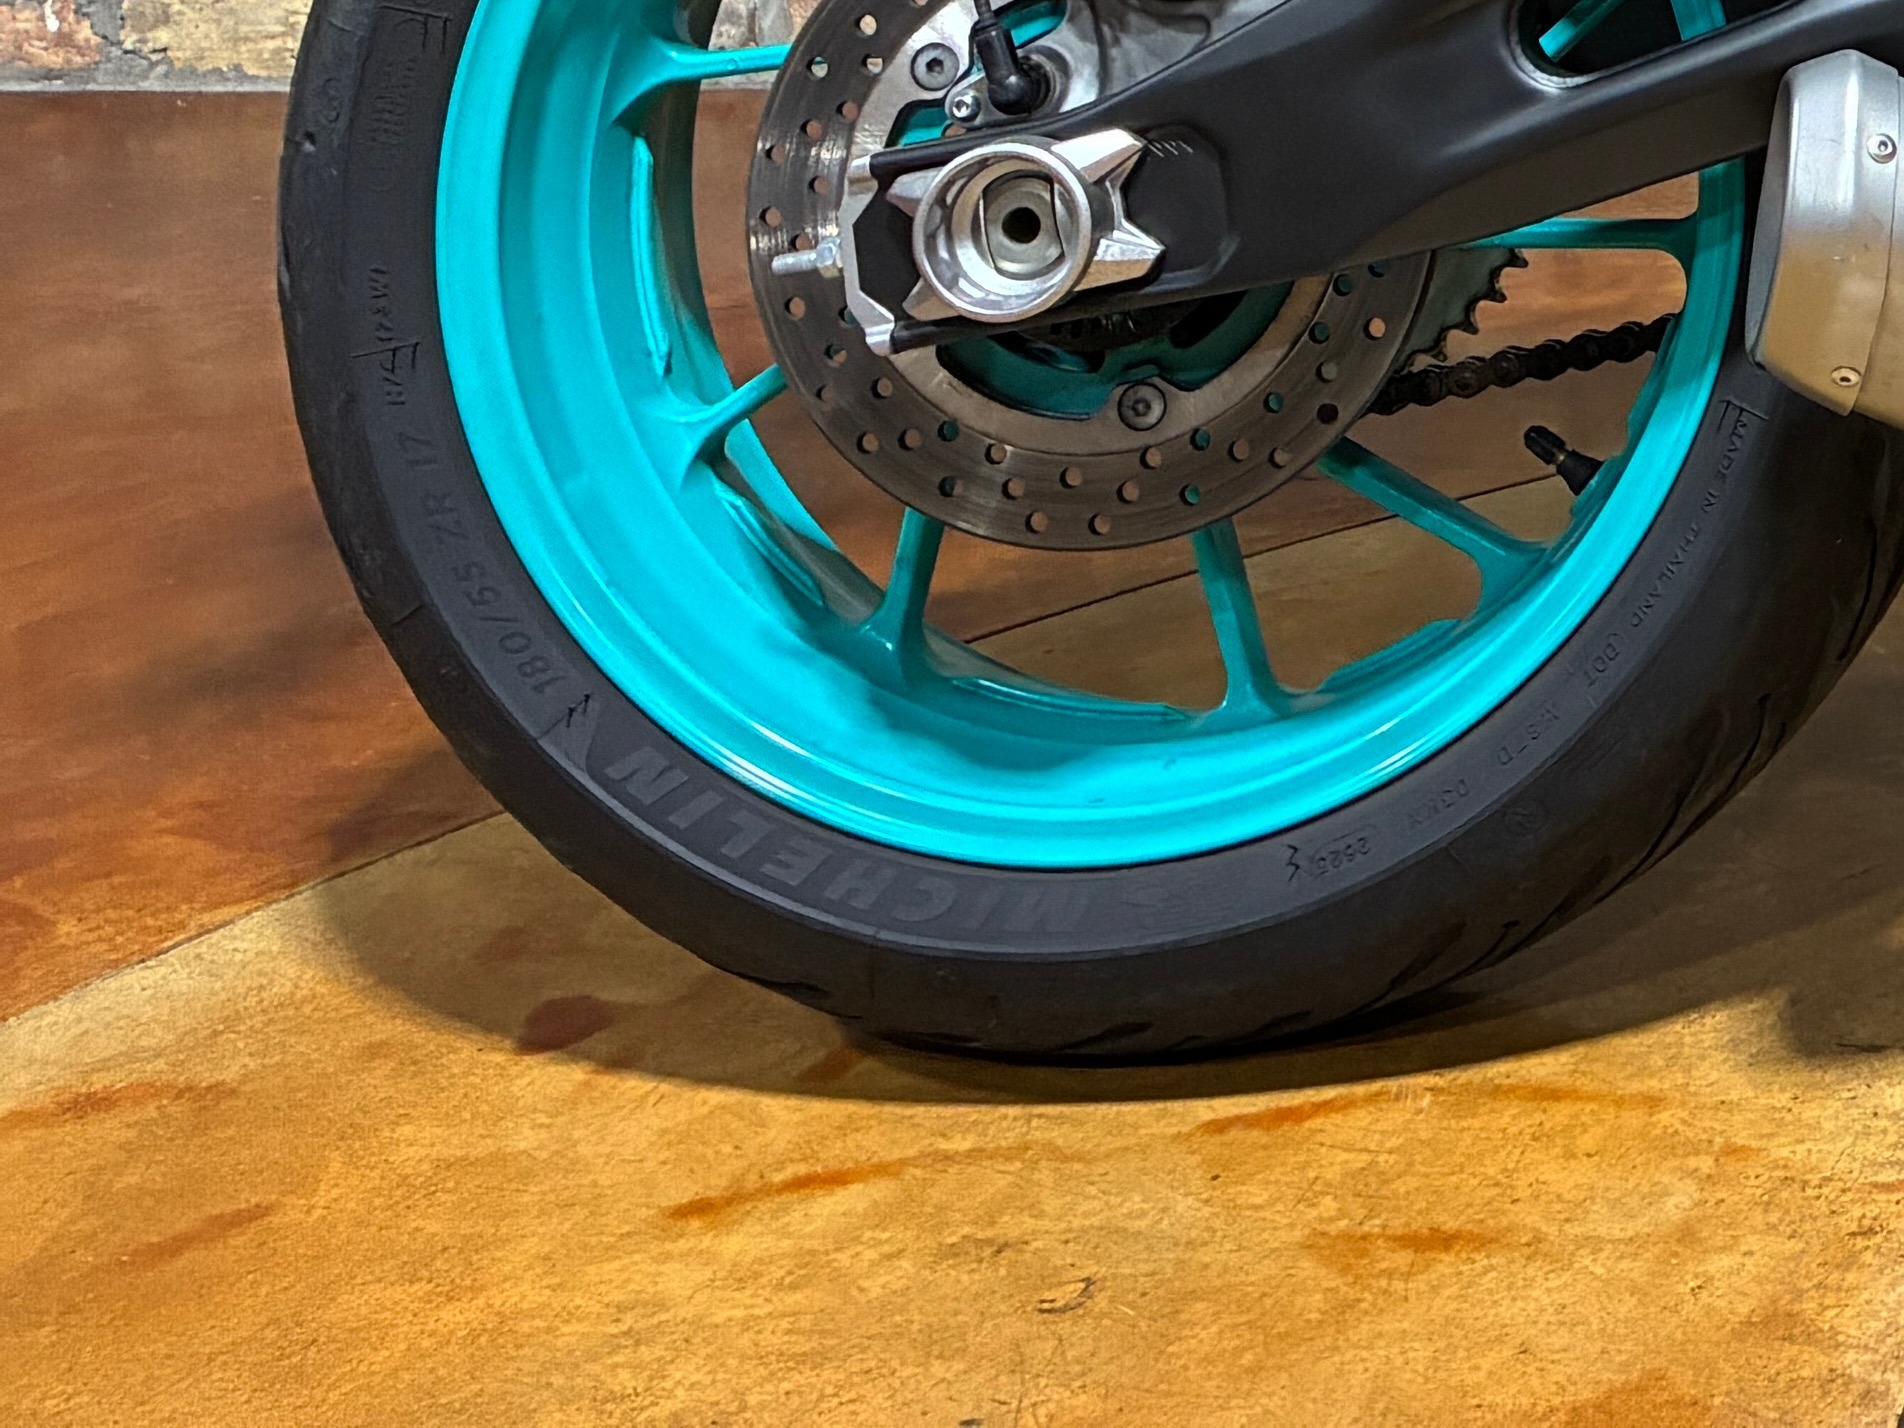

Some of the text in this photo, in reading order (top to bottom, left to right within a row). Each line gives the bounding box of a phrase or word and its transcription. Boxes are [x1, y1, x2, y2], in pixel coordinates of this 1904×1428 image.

[1714, 415, 1751, 484] MADE
[1700, 491, 1720, 516] IN
[450, 559, 567, 696] 180/55
[1630, 523, 1705, 628] THAILAND
[601, 744, 1089, 936] MICHELIN
